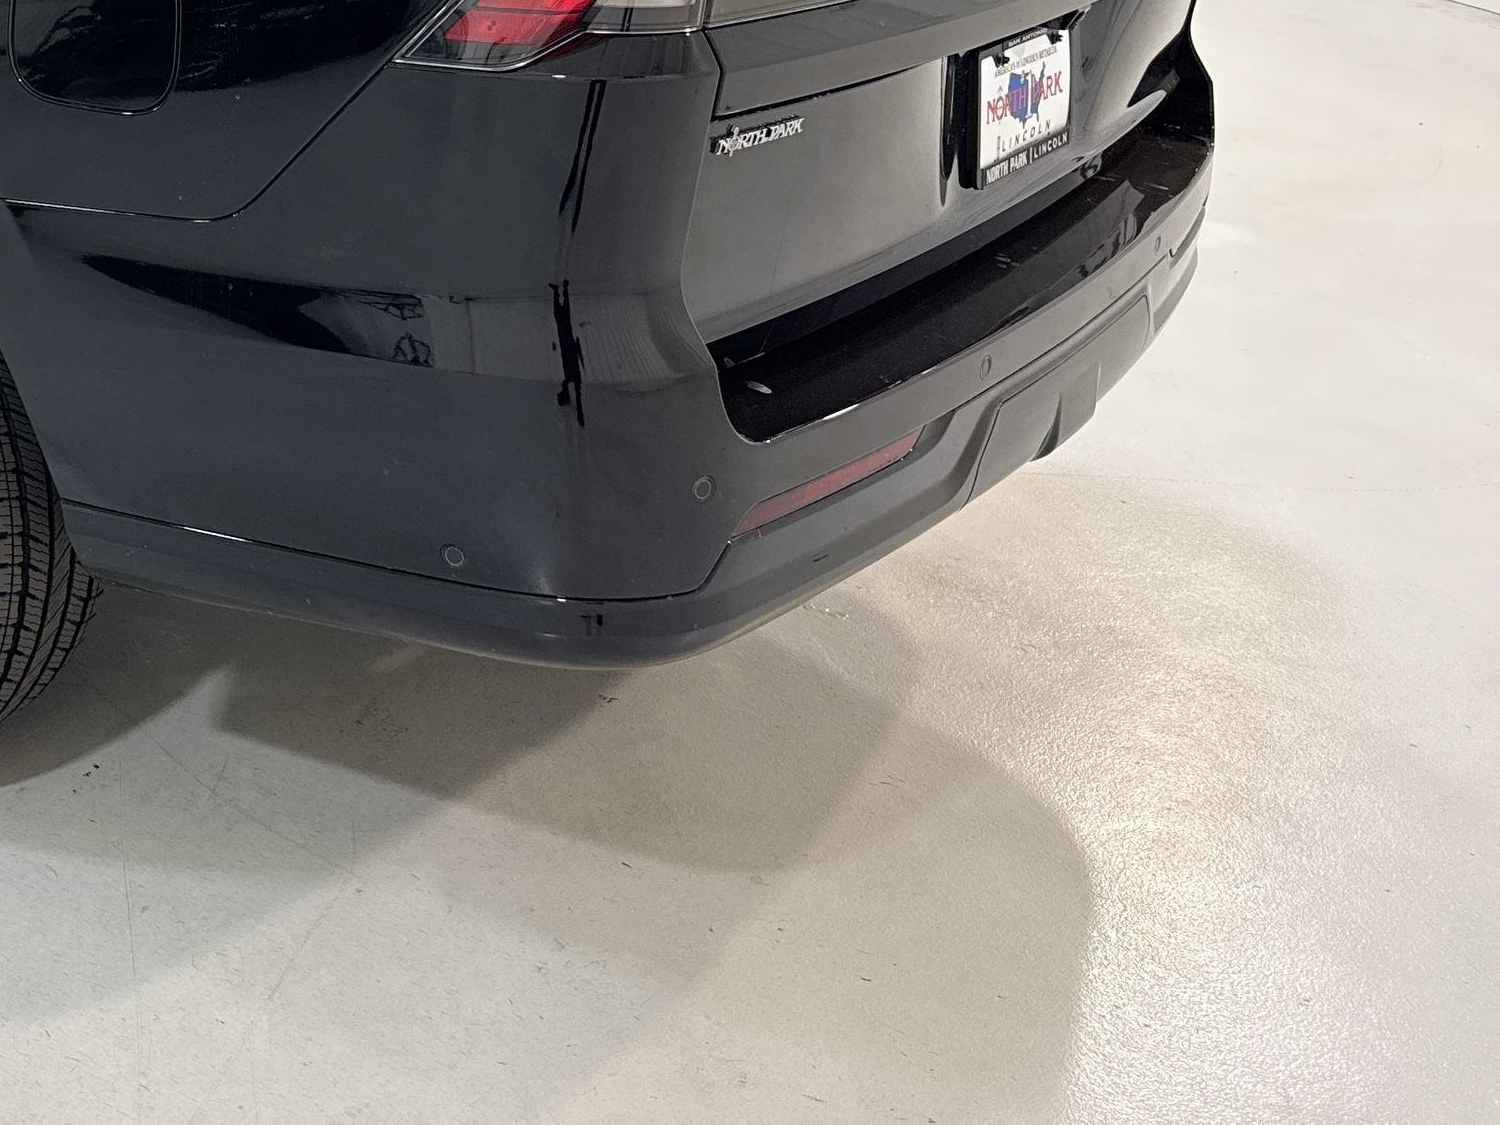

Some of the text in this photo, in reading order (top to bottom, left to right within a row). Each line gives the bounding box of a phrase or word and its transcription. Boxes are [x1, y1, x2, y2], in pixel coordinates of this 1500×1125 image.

[986, 70, 1063, 125] NORTH PARK
[716, 117, 805, 157] NORTH PARK
[986, 131, 1068, 185] NORTH PARK LINCOLN
[1002, 119, 1052, 153] LINCOLN
